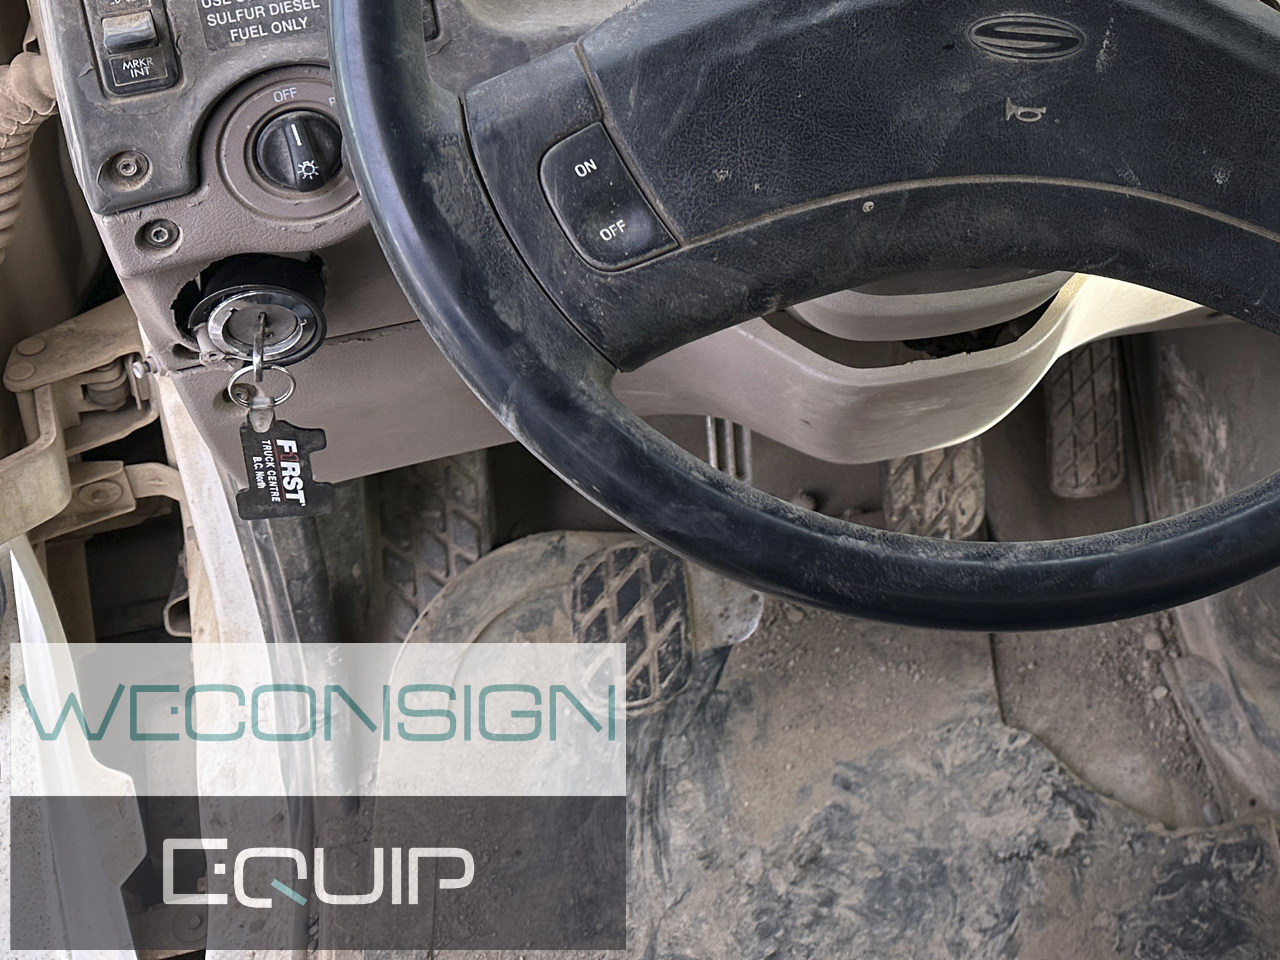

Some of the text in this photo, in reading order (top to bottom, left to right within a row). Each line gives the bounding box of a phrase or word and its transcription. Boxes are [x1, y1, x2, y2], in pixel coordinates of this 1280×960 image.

[206, 5, 266, 27] SULFUR
[230, 16, 309, 42] FUEL ONLY
[122, 56, 154, 71] MRKR
[130, 67, 151, 79] INT
[274, 86, 298, 103] OFF
[574, 158, 598, 177] ON
[599, 219, 626, 241] OFF
[256, 471, 267, 489] North
[261, 439, 281, 503] TRUCK CENTRE
